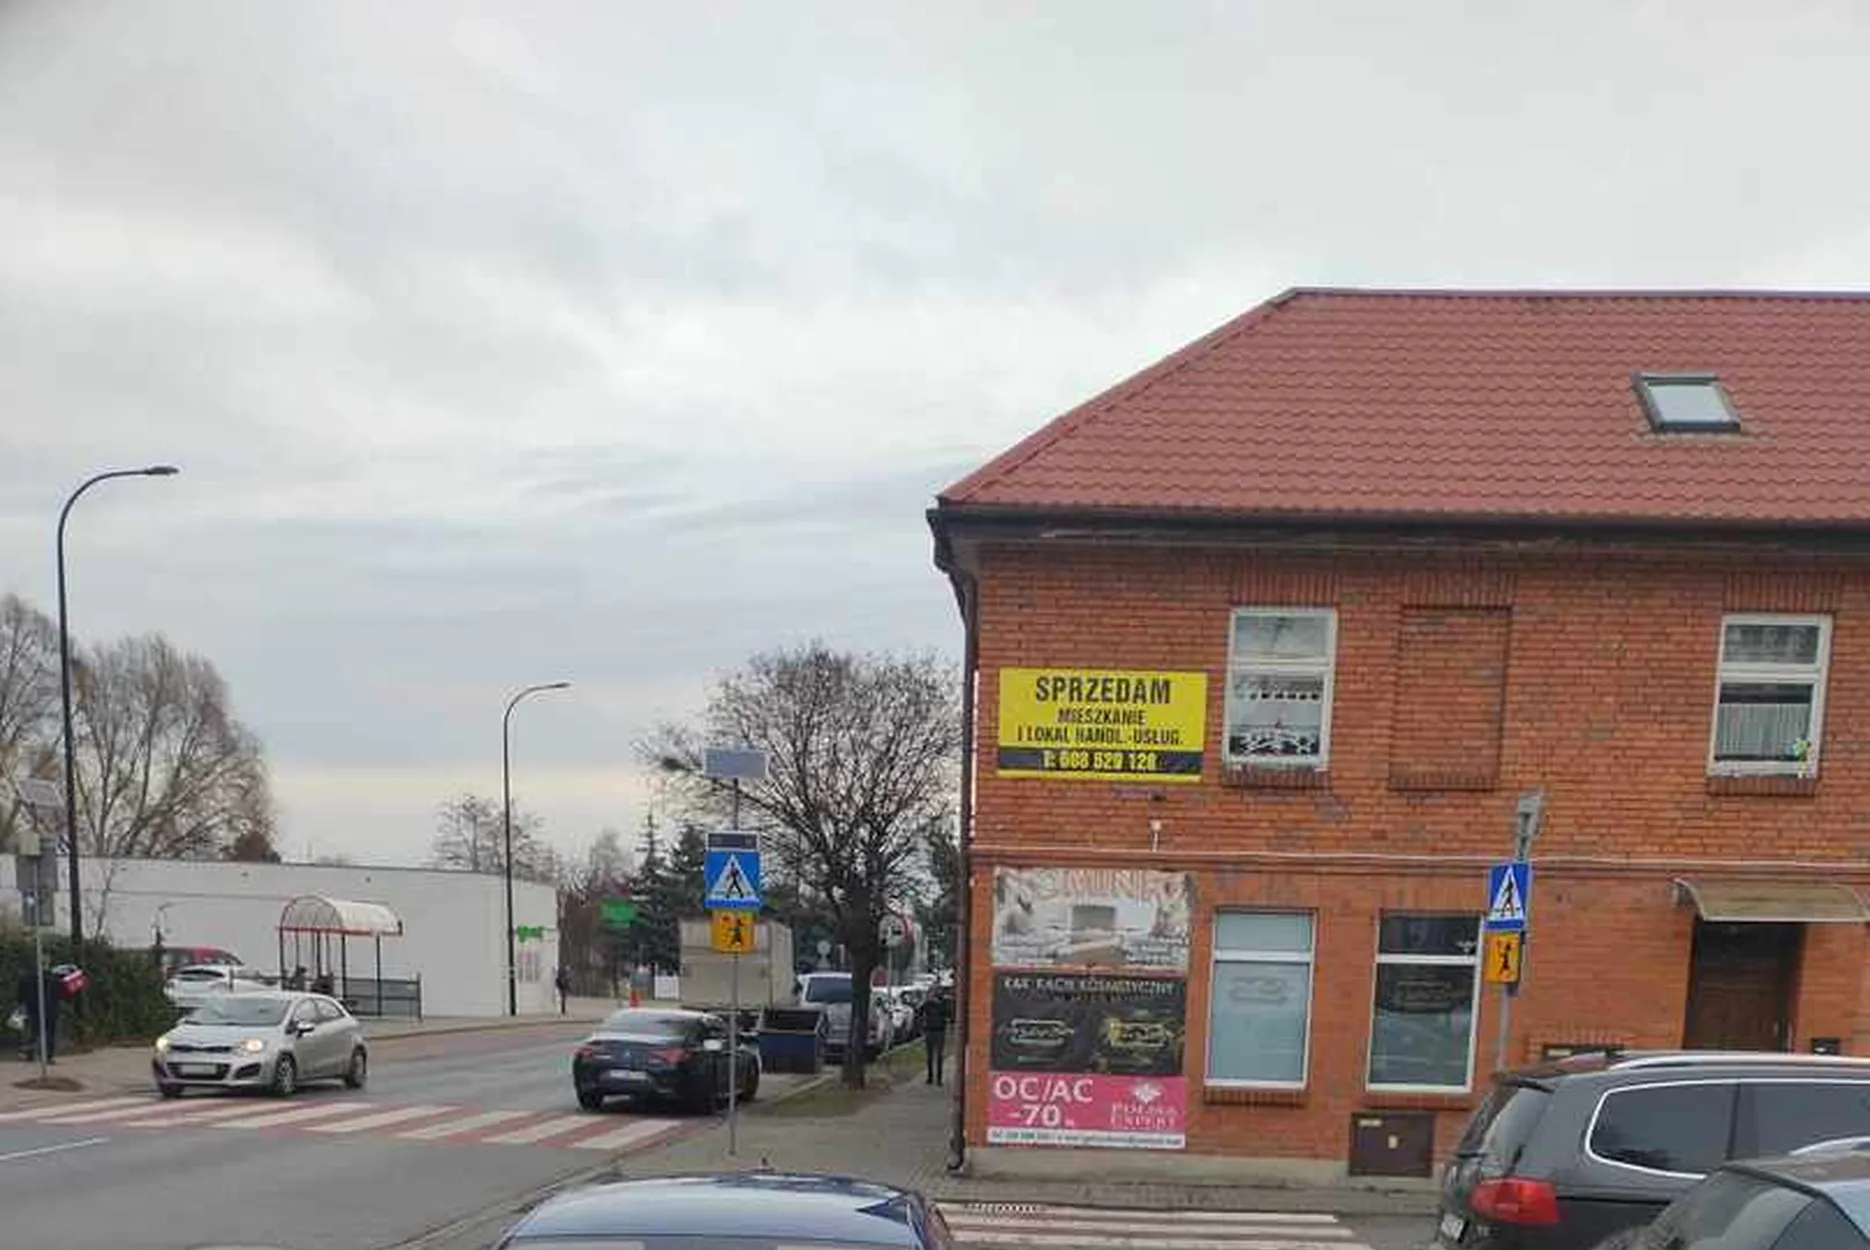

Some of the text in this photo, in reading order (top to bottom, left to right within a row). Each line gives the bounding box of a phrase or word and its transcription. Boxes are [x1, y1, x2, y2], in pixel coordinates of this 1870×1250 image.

[1035, 675, 1171, 704] SPRZEDAM
[1057, 708, 1147, 726] MIESZKANIE
[1017, 725, 1022, 742] I
[1027, 725, 1070, 744] LOKAL
[994, 1077, 1093, 1102] OC/AC
